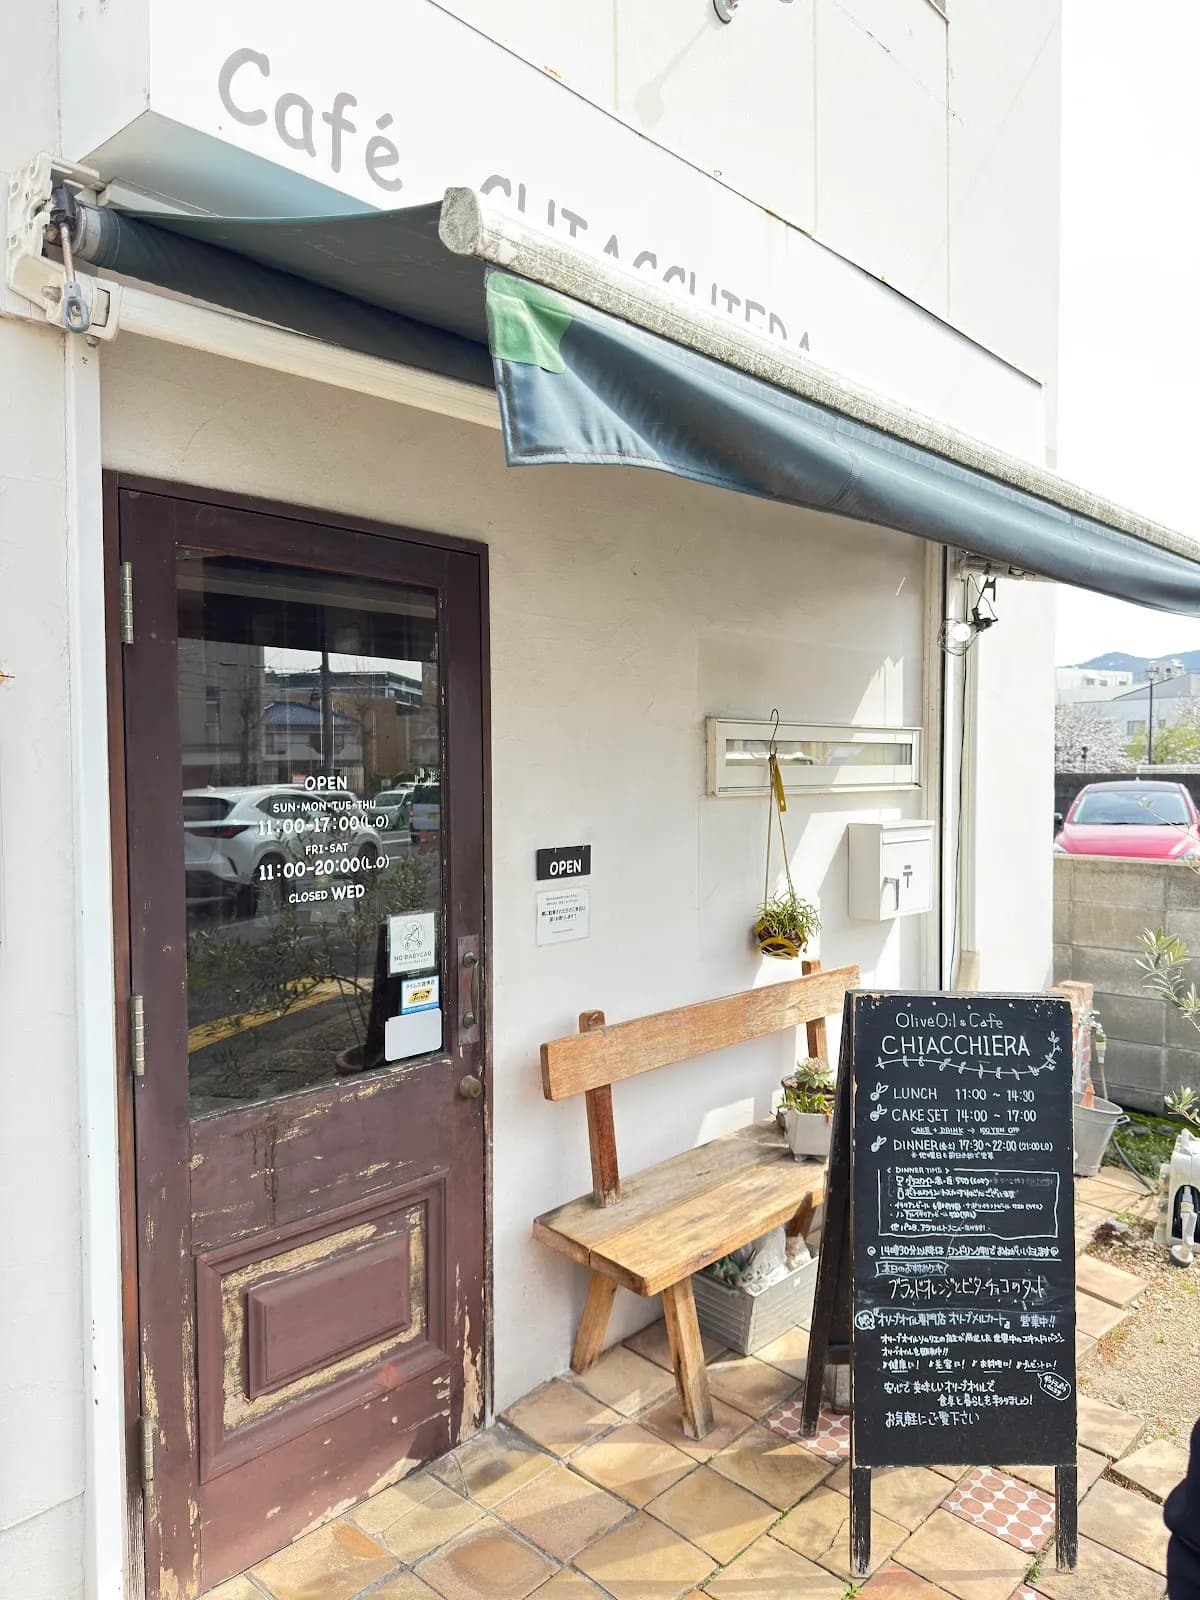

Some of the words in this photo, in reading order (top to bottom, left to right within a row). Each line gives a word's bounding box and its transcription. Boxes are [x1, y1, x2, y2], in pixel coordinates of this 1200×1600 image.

[218, 47, 403, 192] Café
[304, 776, 348, 791] OPEN
[549, 859, 582, 876] OPEN
[288, 890, 328, 903] CLOSED
[330, 884, 366, 900] WED
[881, 1035, 1031, 1056] CHIACCHIERA
[893, 1087, 938, 1100] LUNCH
[955, 1088, 987, 1101] 11:00
[1006, 1089, 1035, 1102] 14:30
[891, 1109, 925, 1122] CAKE
[926, 1109, 949, 1122] SET
[956, 1109, 988, 1123] 14:00
[1007, 1109, 1037, 1122] 17:00
[884, 1411, 980, 1428] お気軽にご覧下さい
